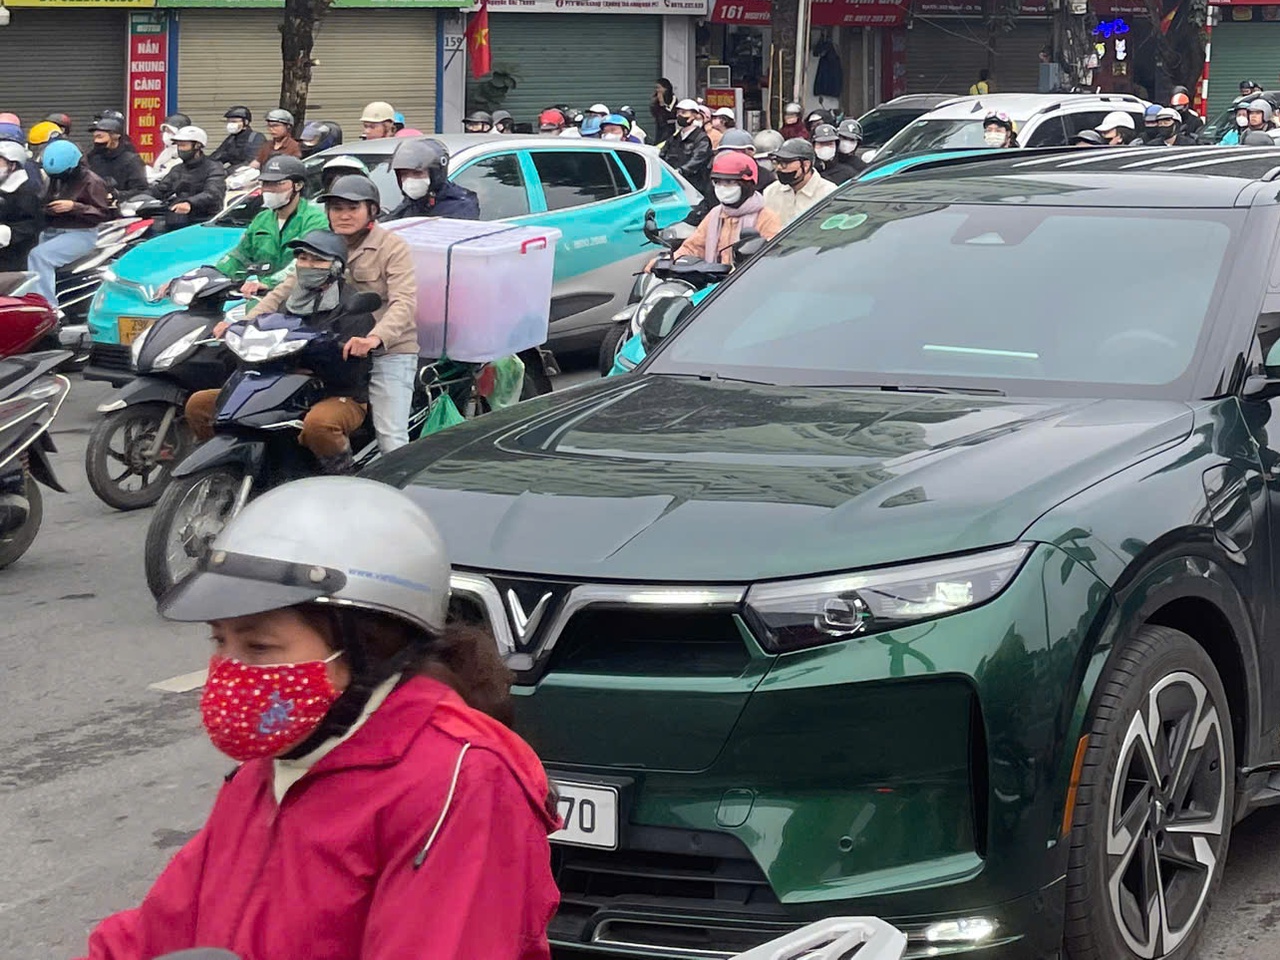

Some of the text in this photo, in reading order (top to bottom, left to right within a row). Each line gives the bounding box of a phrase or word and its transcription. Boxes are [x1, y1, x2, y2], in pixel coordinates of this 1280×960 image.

[720, 5, 744, 19] 161
[445, 35, 463, 48] 159
[131, 60, 165, 73] KHUNG
[140, 133, 154, 146] XE
